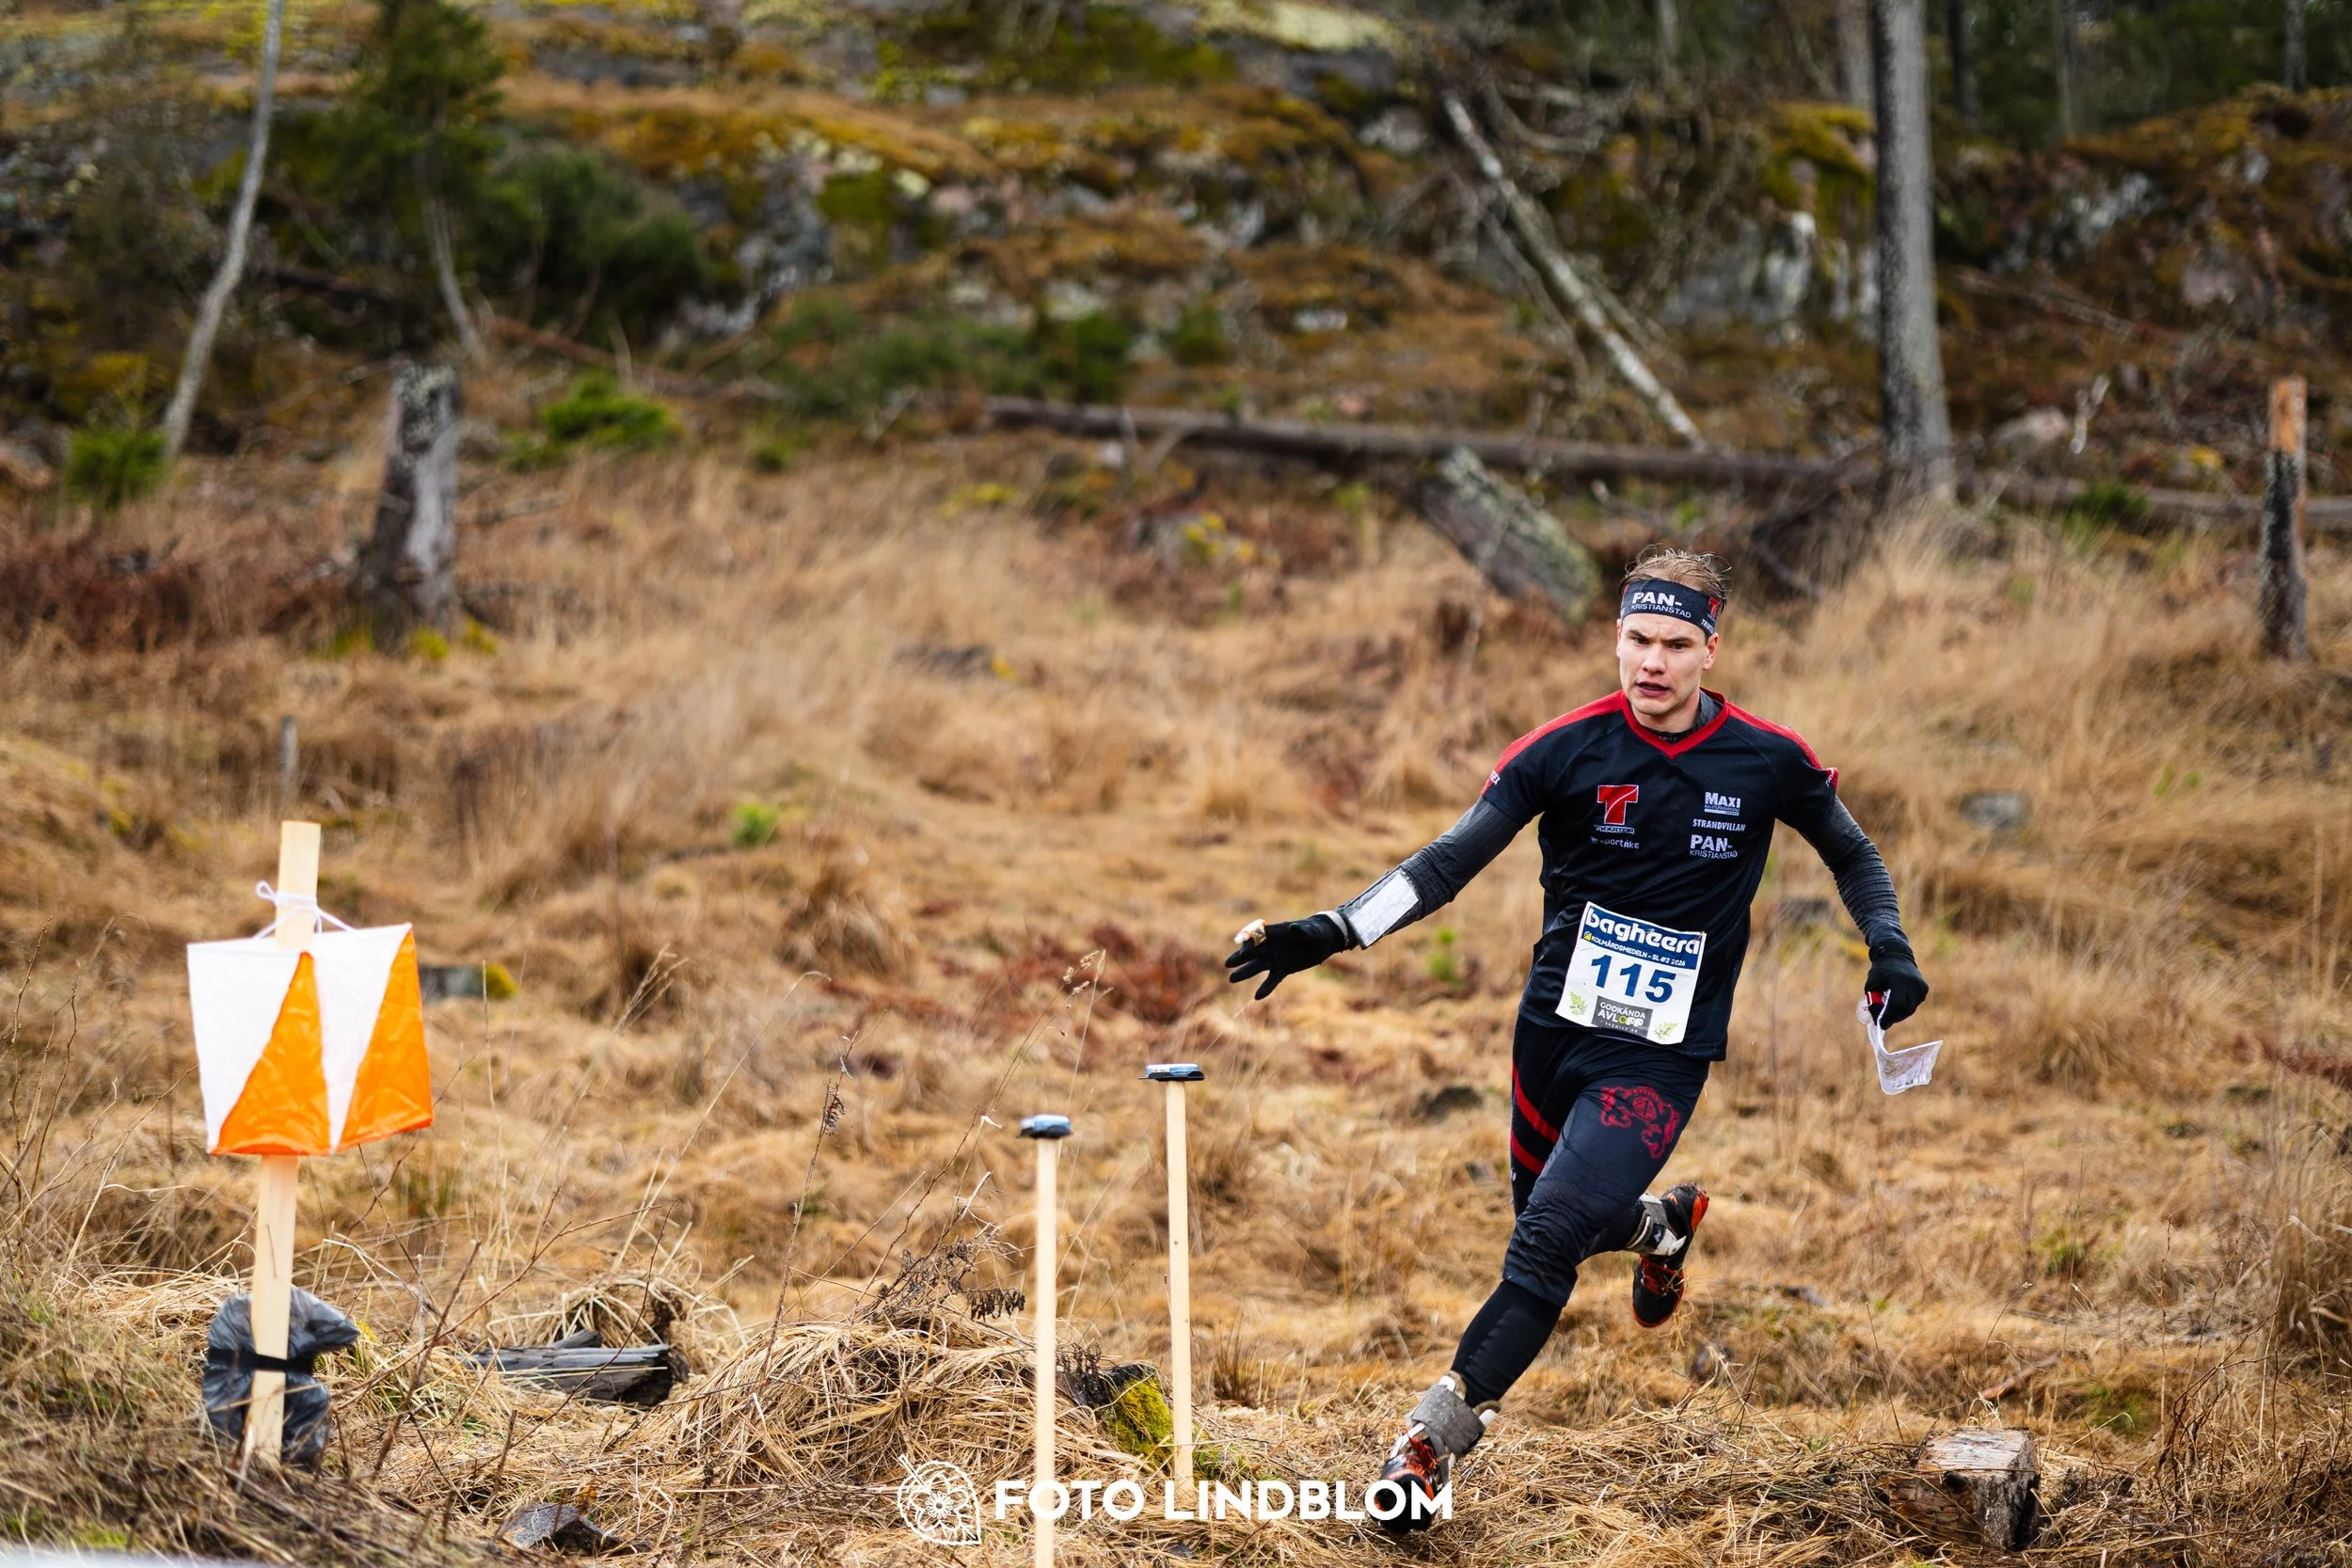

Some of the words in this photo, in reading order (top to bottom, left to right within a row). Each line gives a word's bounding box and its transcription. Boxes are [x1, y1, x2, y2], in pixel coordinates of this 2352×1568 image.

[1632, 592, 1682, 607] PAN-
[1630, 603, 1692, 619] KRISTIANSTAD
[1704, 792, 1741, 808] MAXI
[1692, 818, 1746, 832] STRANDVILLAN
[1690, 834, 1733, 852] PAN-
[1689, 849, 1739, 860] KRISTIANSTAD
[1584, 908, 1700, 955] bagheera
[1591, 936, 1648, 958] KOLMÅRDSMEDELN
[1671, 958, 1686, 967] 2026
[1591, 954, 1677, 1004] 115
[1599, 1002, 1646, 1020] GODKÄNDA
